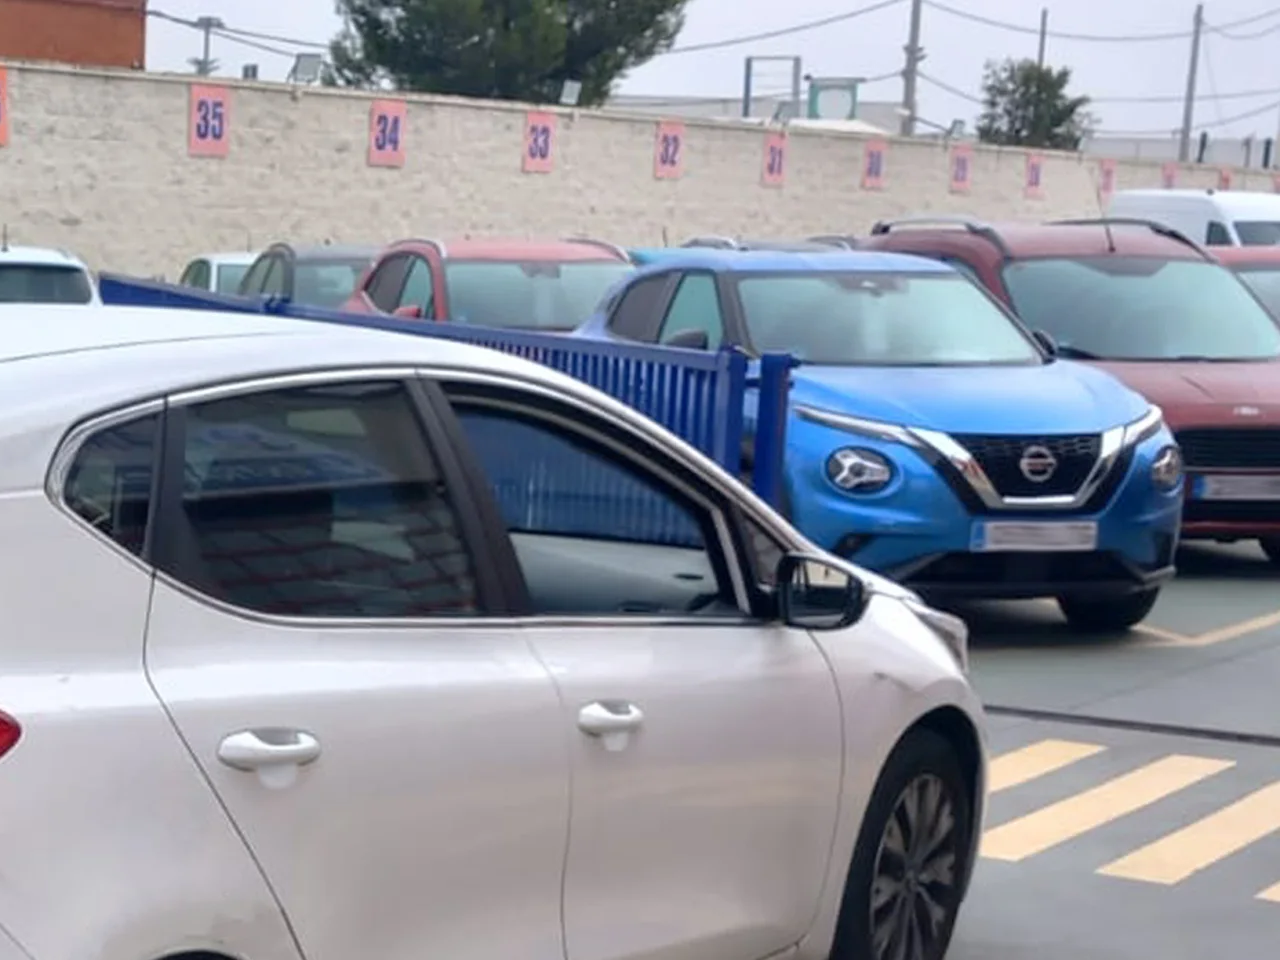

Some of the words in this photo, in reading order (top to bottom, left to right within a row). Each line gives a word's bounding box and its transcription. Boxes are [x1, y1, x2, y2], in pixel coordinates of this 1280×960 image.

[196, 99, 224, 140] 35
[375, 114, 400, 151] 34
[529, 125, 551, 160] 33
[661, 134, 680, 166] 32
